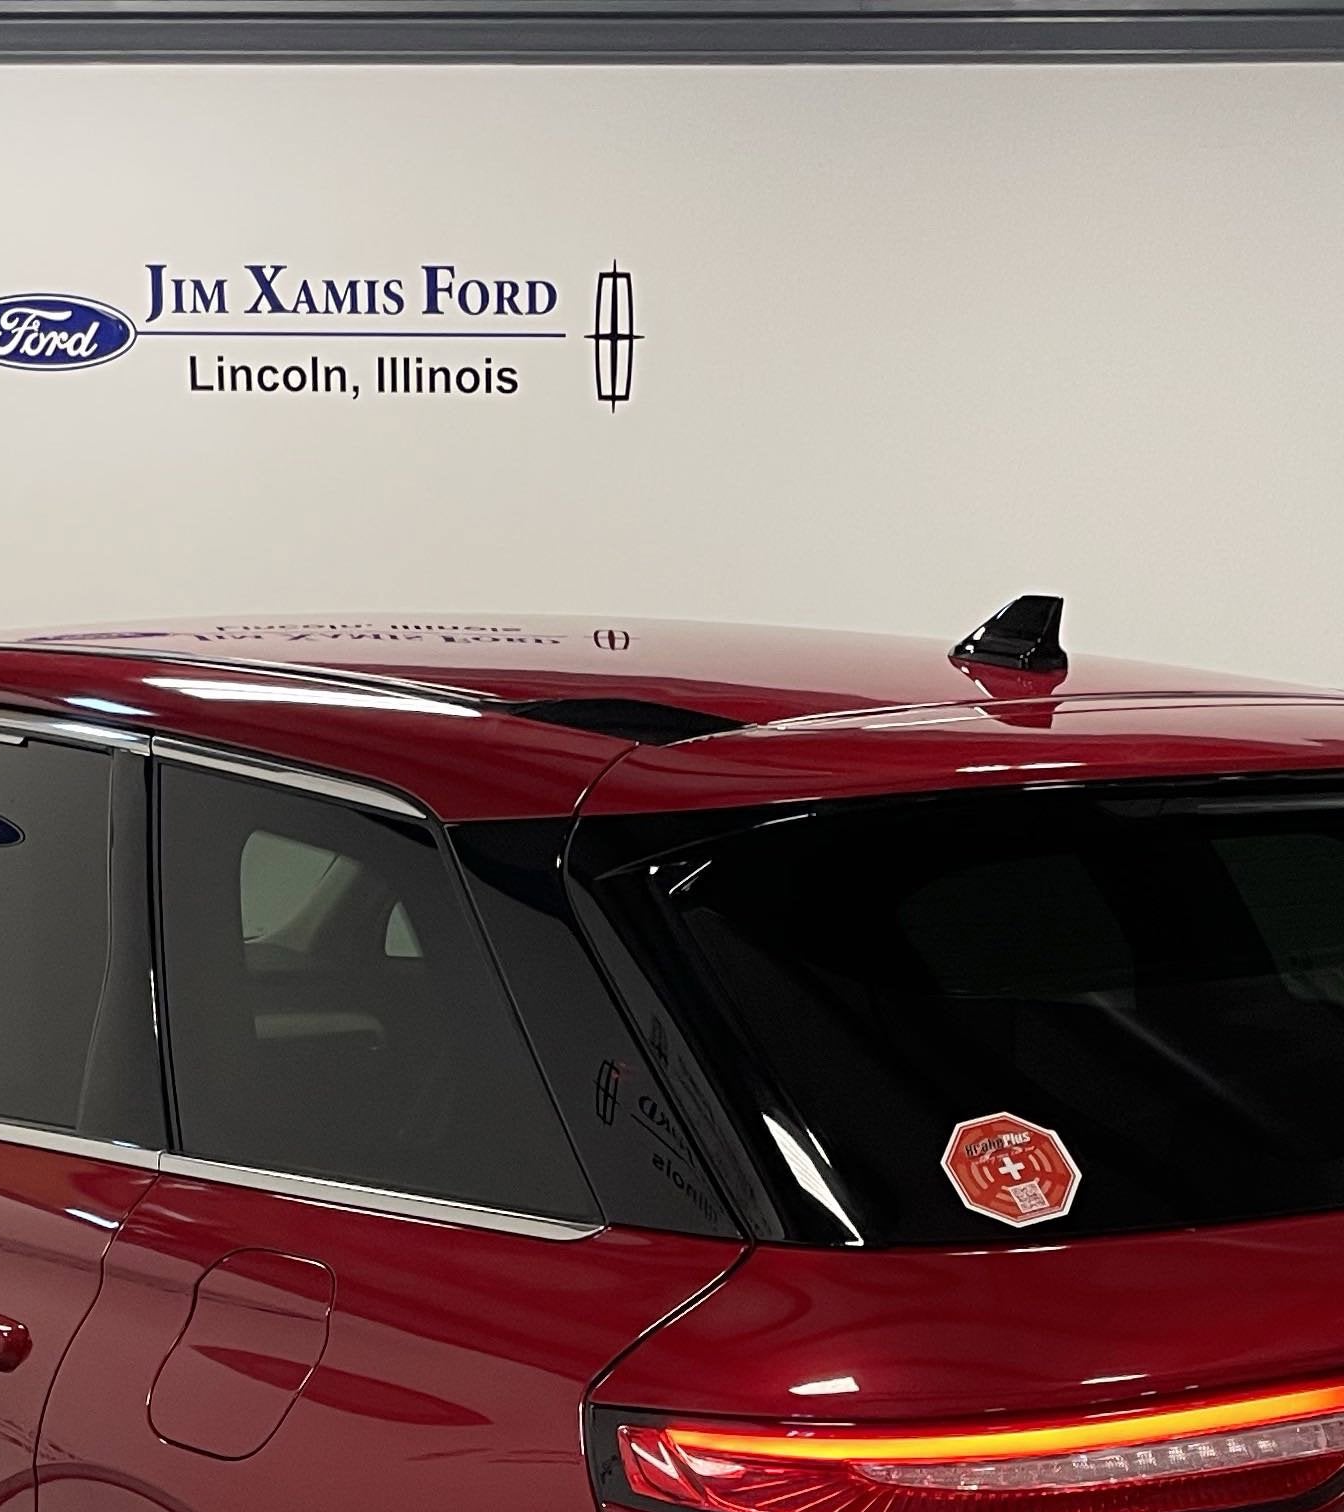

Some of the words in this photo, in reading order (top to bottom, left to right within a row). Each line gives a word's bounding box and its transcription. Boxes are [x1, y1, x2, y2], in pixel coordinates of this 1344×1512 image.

[146, 265, 229, 322] JIM
[243, 265, 405, 316] XAMIS
[422, 265, 558, 316] FORD
[190, 355, 360, 399] Lincoln,
[378, 356, 519, 394] Illinois
